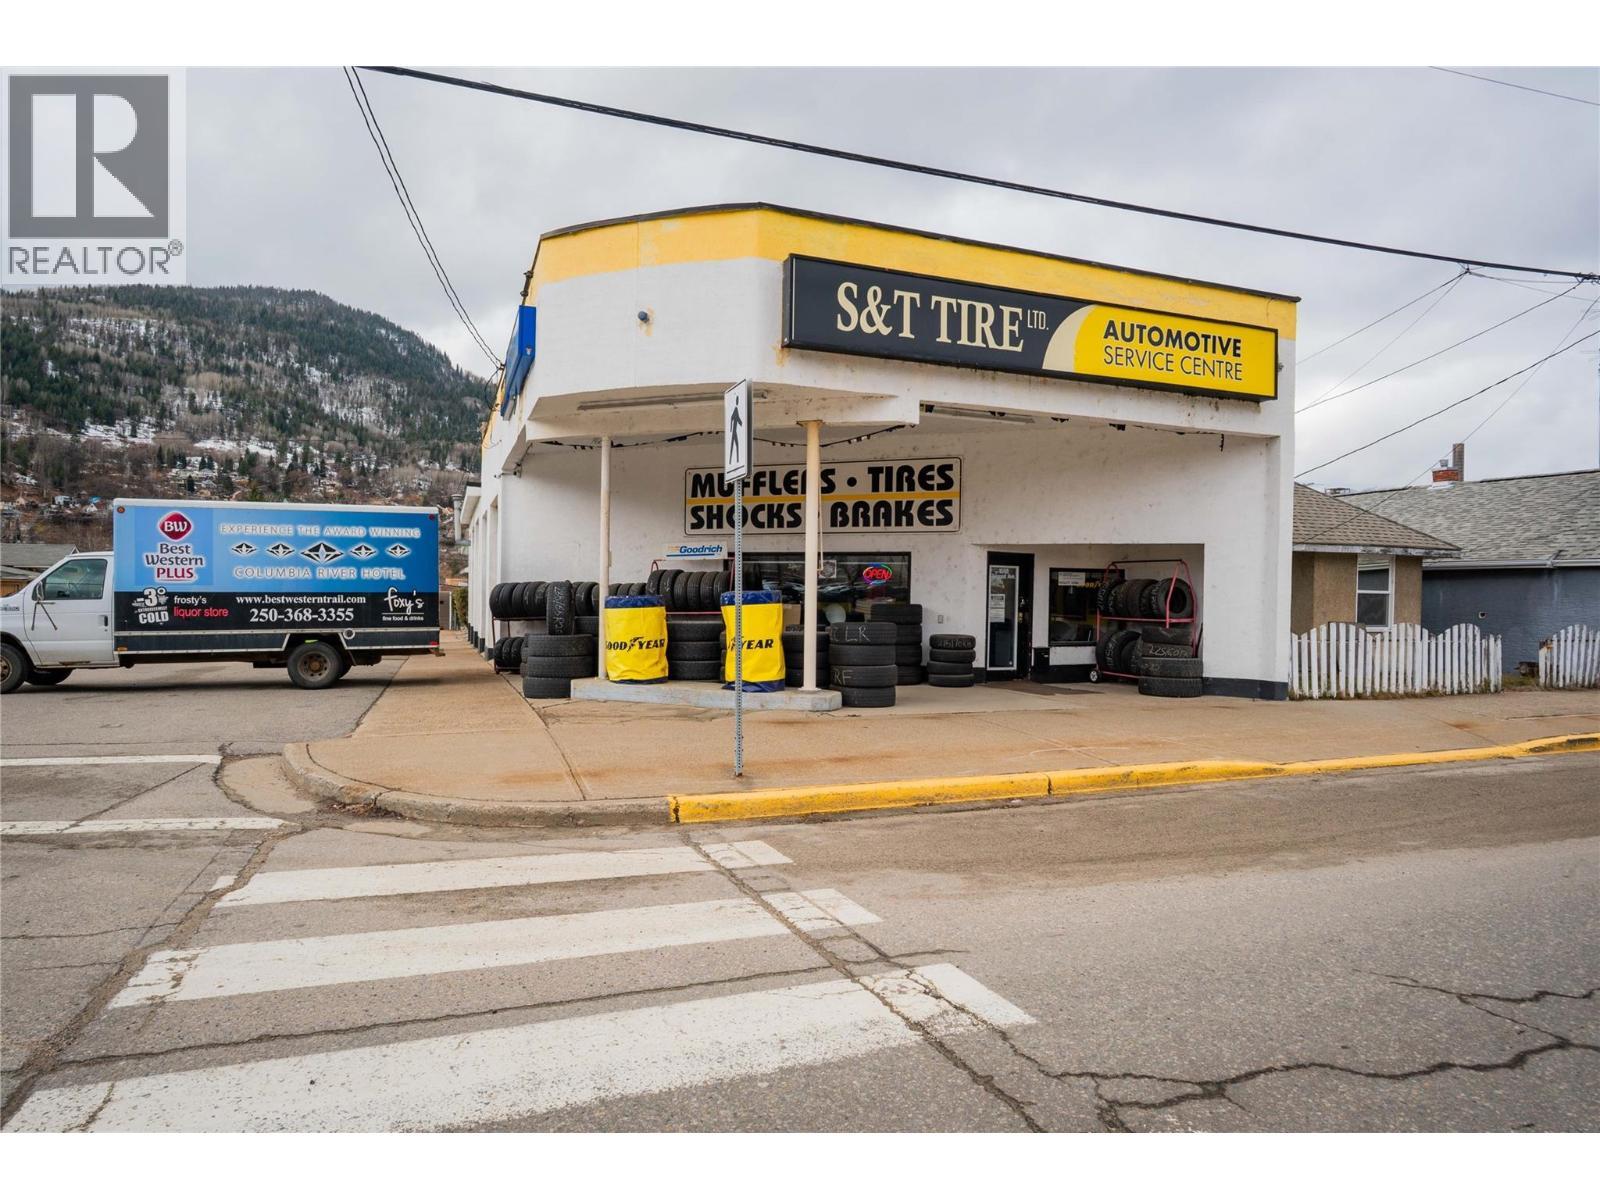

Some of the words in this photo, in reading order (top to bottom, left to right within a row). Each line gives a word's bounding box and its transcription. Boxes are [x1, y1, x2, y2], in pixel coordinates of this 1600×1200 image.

[836, 281, 921, 339] S&T
[930, 295, 1025, 352] TIRE
[1027, 309, 1049, 331] LTD.
[1103, 319, 1242, 358] AUTOMOTIVE
[1103, 345, 1175, 372] SERVICE
[1180, 355, 1243, 381] CENTRE
[867, 463, 954, 493] TIRES
[690, 502, 803, 530] SHOCKS
[830, 499, 954, 528] BRAKES
[163, 520, 189, 533] BW
[220, 524, 294, 535] EXPERIENCE
[298, 525, 320, 536] THE
[324, 526, 366, 537] AWARD
[369, 527, 421, 538] WINNING
[159, 543, 191, 555] Best
[145, 554, 204, 566] Western
[156, 567, 195, 579] PLUS
[234, 567, 312, 578] COLUMBIA
[317, 568, 357, 579] RIVER
[361, 568, 406, 580] HOTEL
[864, 568, 892, 580] OPEN
[173, 595, 207, 606] frosty's
[235, 595, 366, 605] www.bestwesterntrail.com
[383, 586, 425, 615] foxy's
[138, 611, 169, 625] COLD
[173, 607, 202, 619] liquor
[203, 607, 229, 617] store
[249, 607, 354, 622] 250-368-3355
